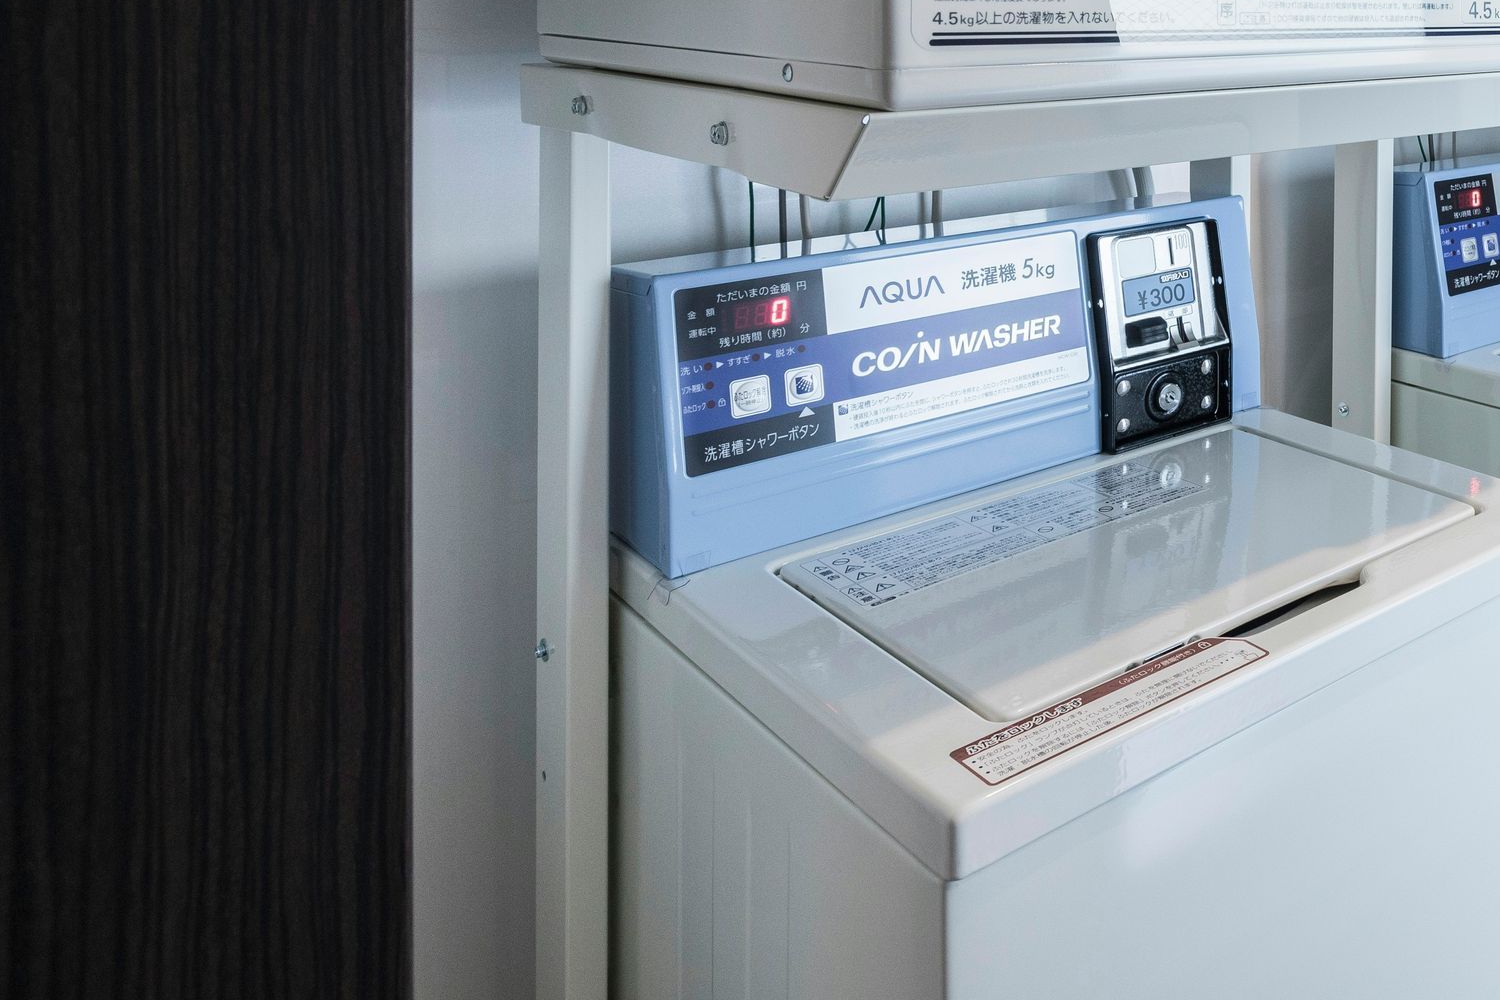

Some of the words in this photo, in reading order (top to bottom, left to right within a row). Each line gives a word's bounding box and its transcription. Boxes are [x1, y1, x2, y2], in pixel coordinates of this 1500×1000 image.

[1472, 191, 1480, 207] 0
[1174, 233, 1188, 249] 100
[859, 275, 945, 309] AQUA
[961, 263, 1017, 290] 洗濯機
[1022, 258, 1055, 280] 5kg
[1454, 270, 1499, 288] 洗濯槽シャワーボタン
[717, 281, 790, 303] ただいまの金額
[796, 280, 807, 291] 円
[1138, 283, 1184, 310] ¥300
[687, 308, 715, 321] 金額
[771, 298, 789, 323] 0
[688, 327, 716, 339] 運転中
[800, 323, 810, 333] 分
[852, 331, 940, 377] COIN
[950, 315, 1061, 356] WASHER
[680, 365, 702, 376] 洗い
[727, 355, 751, 366] すすぎ
[775, 347, 796, 358] 脱水
[683, 403, 706, 414] ふたロック
[704, 424, 819, 463] 洗濯槽シャワーボタン
[966, 697, 1084, 756] ふたをロックします
